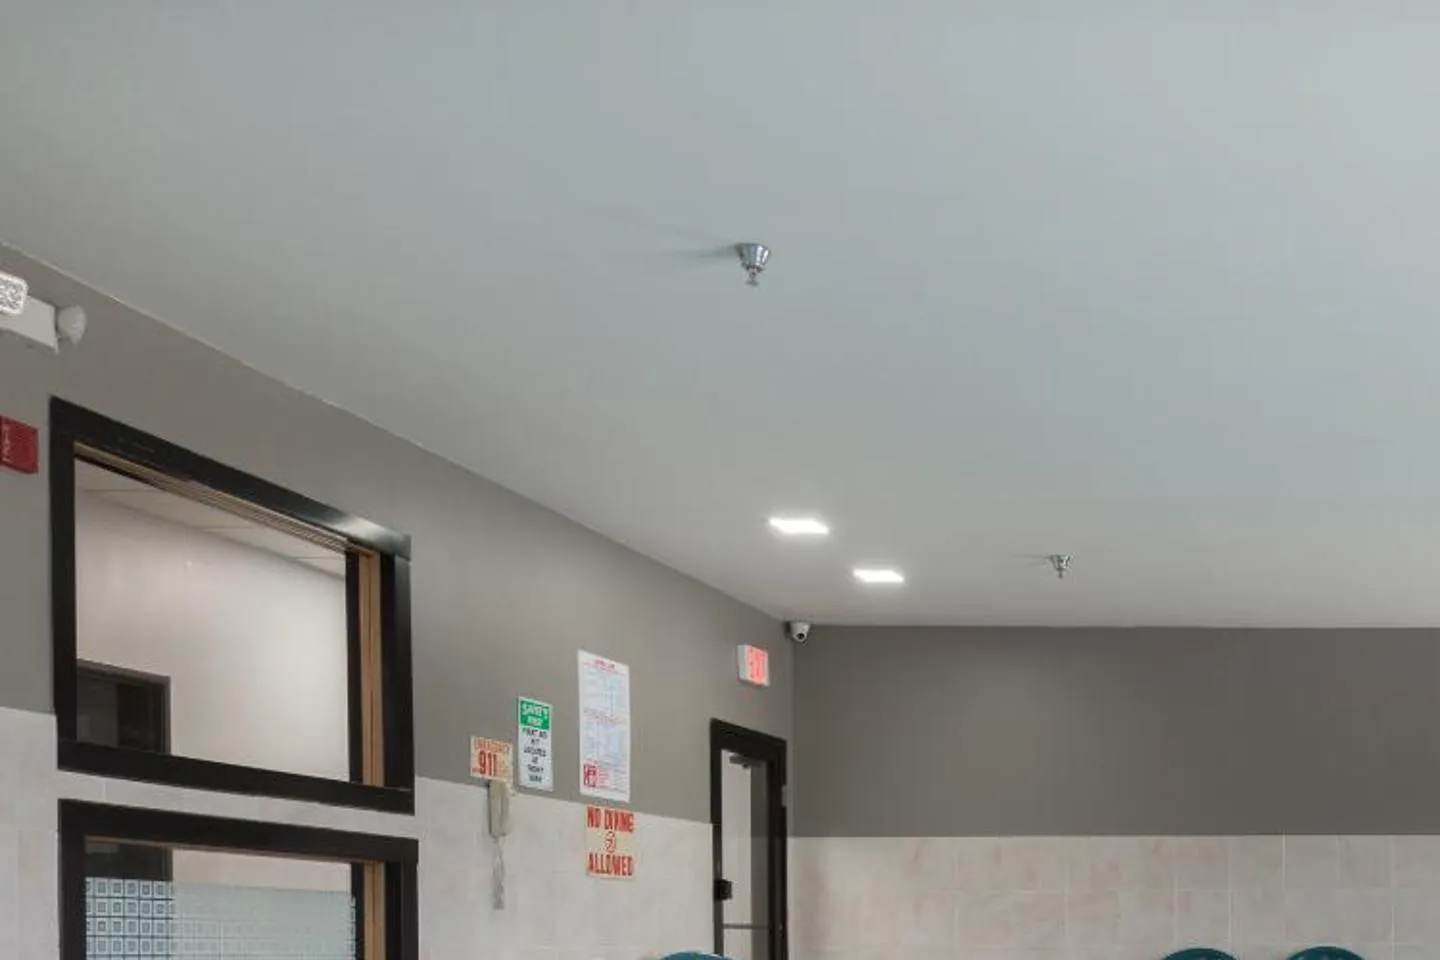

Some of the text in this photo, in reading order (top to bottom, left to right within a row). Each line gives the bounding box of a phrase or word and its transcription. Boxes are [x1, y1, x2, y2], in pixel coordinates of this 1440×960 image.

[479, 749, 497, 777] 911
[587, 805, 634, 833] NO DIVING
[588, 852, 633, 876] ALLOWED
